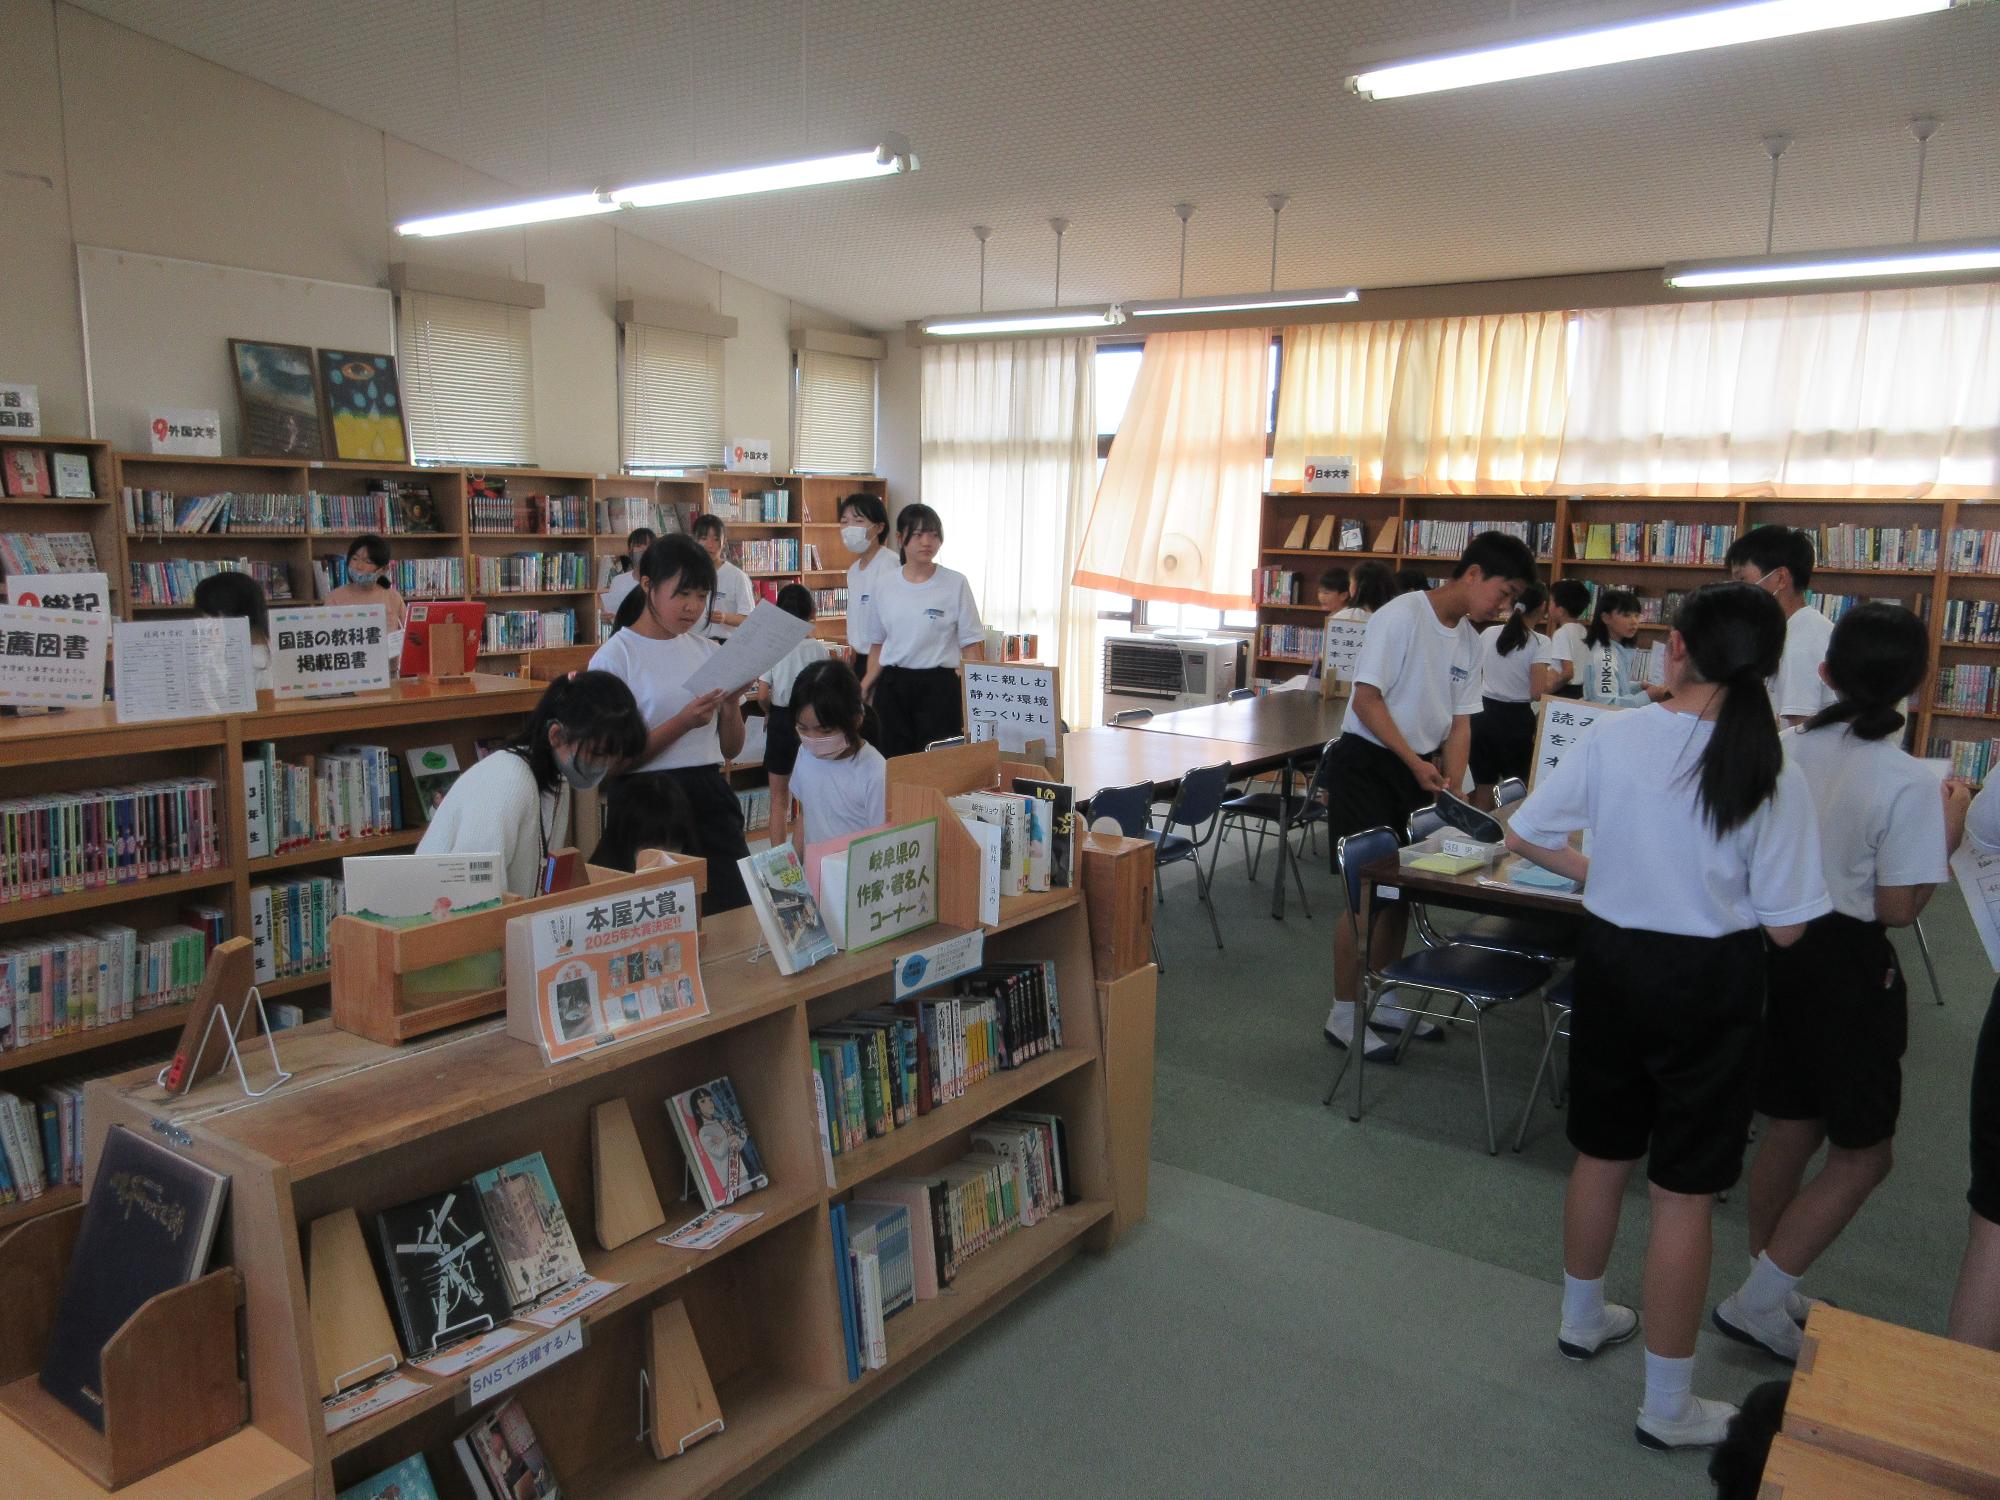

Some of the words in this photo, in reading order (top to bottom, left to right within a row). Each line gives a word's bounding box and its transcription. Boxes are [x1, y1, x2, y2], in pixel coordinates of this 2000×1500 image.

[279, 626, 381, 650] 国語の教科書
[1331, 626, 1365, 635] 読み
[0, 630, 89, 660] 薦図書
[297, 651, 367, 673] 掲載図書
[969, 672, 1047, 688] 本に親しむ
[970, 689, 1049, 707] 静かな環境
[972, 707, 1049, 724] をつくりまし
[1550, 734, 1577, 747] を
[248, 787, 260, 843] 3年生
[869, 840, 920, 867] 岐阜県の
[857, 865, 930, 908] 作家・著名人
[586, 890, 677, 933] 本屋大賞
[870, 902, 917, 932] コーナー
[472, 1329, 576, 1393] SNSで活躍する人
